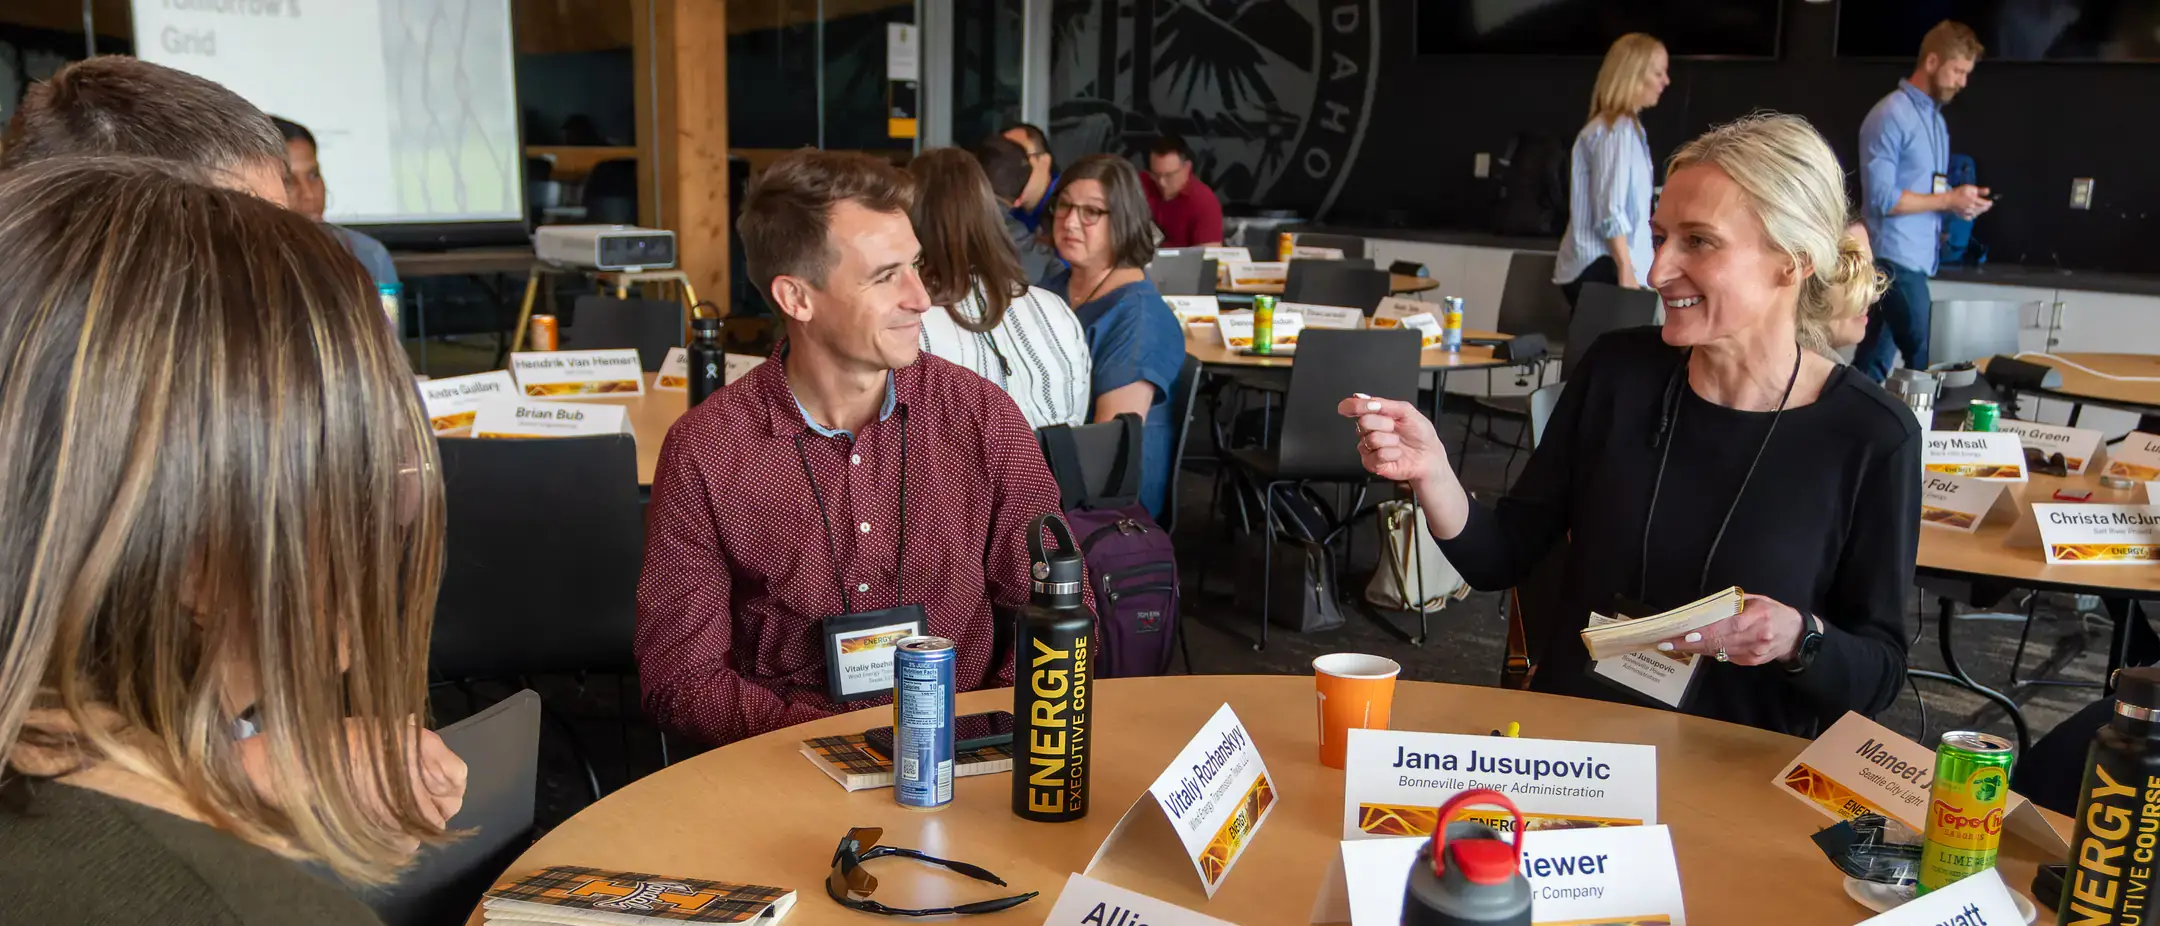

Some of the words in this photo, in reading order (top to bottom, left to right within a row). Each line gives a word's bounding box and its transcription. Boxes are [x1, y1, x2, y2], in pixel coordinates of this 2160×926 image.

[160, 25, 217, 56] Grid
[567, 357, 590, 367] Van
[592, 356, 637, 366] Hemert
[515, 407, 552, 419] Brian
[556, 408, 584, 421] Bub
[1951, 438, 1988, 450] Msall
[1996, 424, 2026, 438] ustin
[2029, 428, 2071, 443] Green
[1928, 478, 1960, 493] Folz
[2049, 511, 2109, 525] Christa
[2111, 547, 2144, 555] ENERGY
[863, 635, 892, 646] ENERGY
[845, 663, 870, 674] Vitaliy
[870, 661, 893, 670] Rozha
[1073, 636, 1087, 711] COURSE
[1028, 636, 1069, 813] ENERGY
[1069, 713, 1085, 812] EXECUTIVE
[1164, 777, 1203, 819] Vitaliy
[1192, 724, 1246, 788] Rozhanskyy
[1392, 745, 1458, 771] Jana
[1466, 749, 1611, 781] Jusupovic
[1855, 738, 1929, 785] Maneet
[1398, 775, 1465, 790] Bonneville
[1468, 779, 1507, 792] Power
[1511, 782, 1605, 798] Administration
[1858, 767, 1886, 787] Seattle
[1885, 782, 1902, 798] City
[1900, 789, 1925, 808] Light
[1229, 810, 1248, 840] ENERGY
[1934, 799, 1981, 830] Topo
[2133, 775, 2160, 863] COURSE
[2067, 763, 2137, 926] NERGY
[1523, 851, 1608, 878] iewer
[1939, 851, 1973, 867] LIME
[1542, 885, 1605, 901] Company
[2119, 866, 2150, 926] UTIVE
[1081, 902, 1149, 926] Alli
